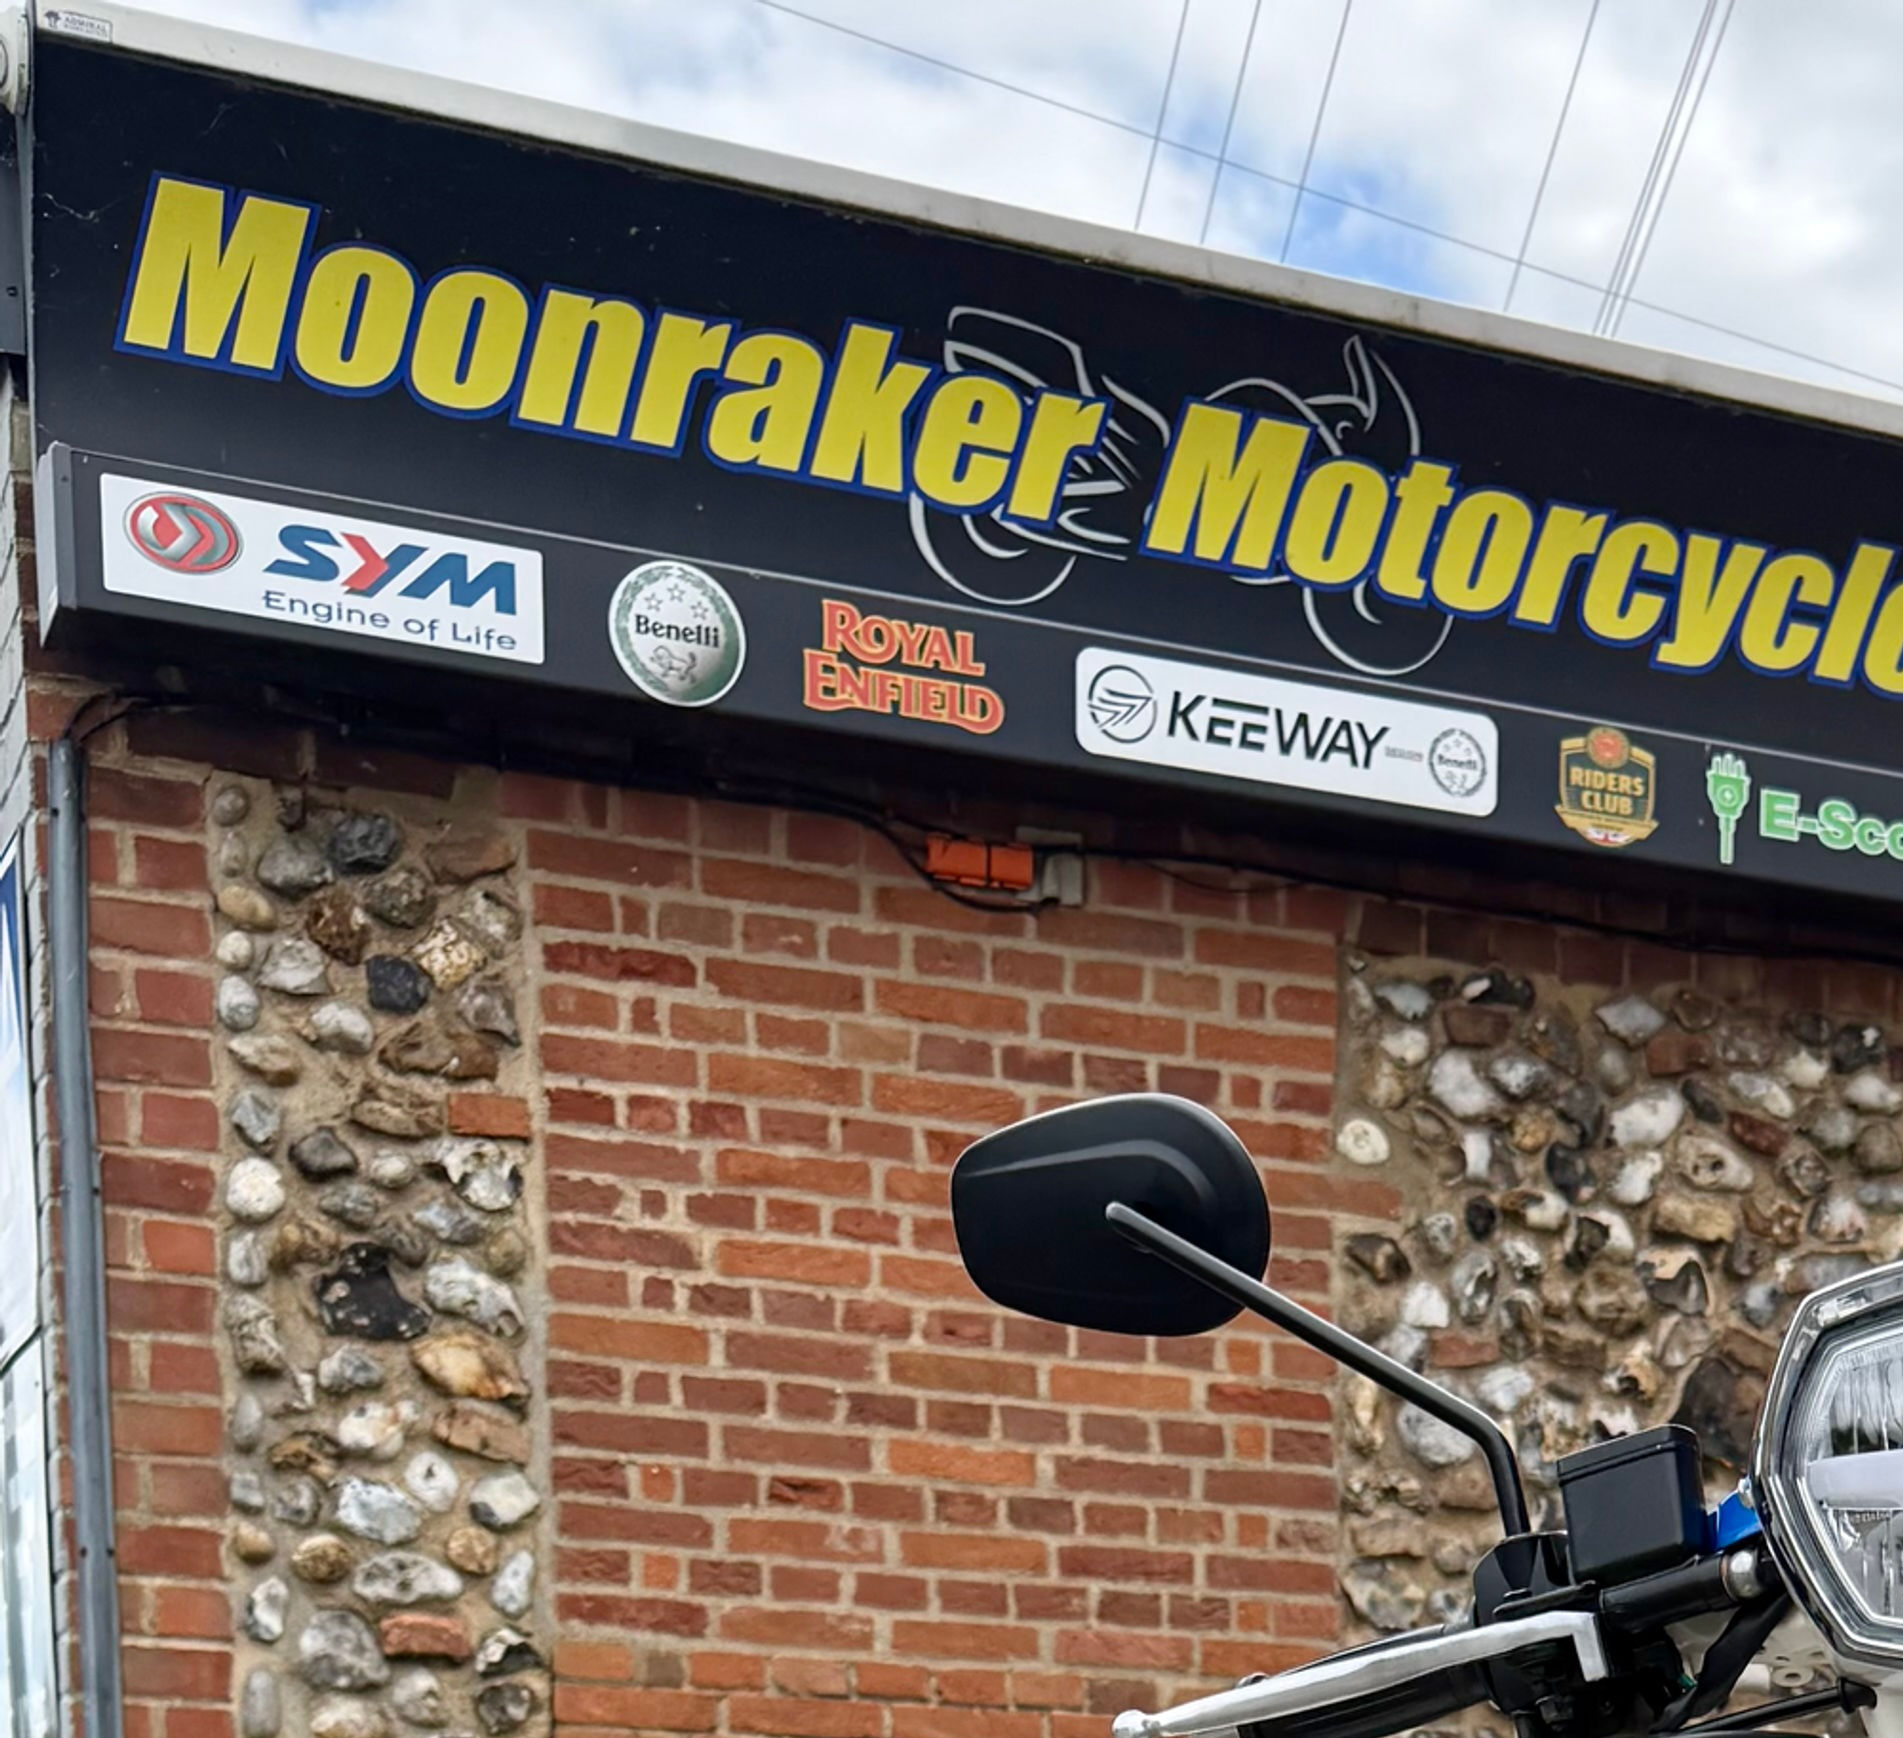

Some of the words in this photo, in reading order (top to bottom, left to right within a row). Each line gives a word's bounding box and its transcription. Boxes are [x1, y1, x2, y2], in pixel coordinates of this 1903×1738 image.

[117, 172, 1111, 528] Moonraker
[262, 524, 517, 616] SYM
[262, 590, 390, 628] Engine
[403, 618, 439, 642] of
[452, 622, 517, 651] Life
[634, 614, 721, 649] Benelli
[822, 598, 985, 677] ROYAL
[803, 648, 1005, 735] ENFIELD
[1167, 690, 1390, 770] KEEWAY
[1569, 766, 1645, 797] RIDERS
[1581, 790, 1633, 815] CLUB
